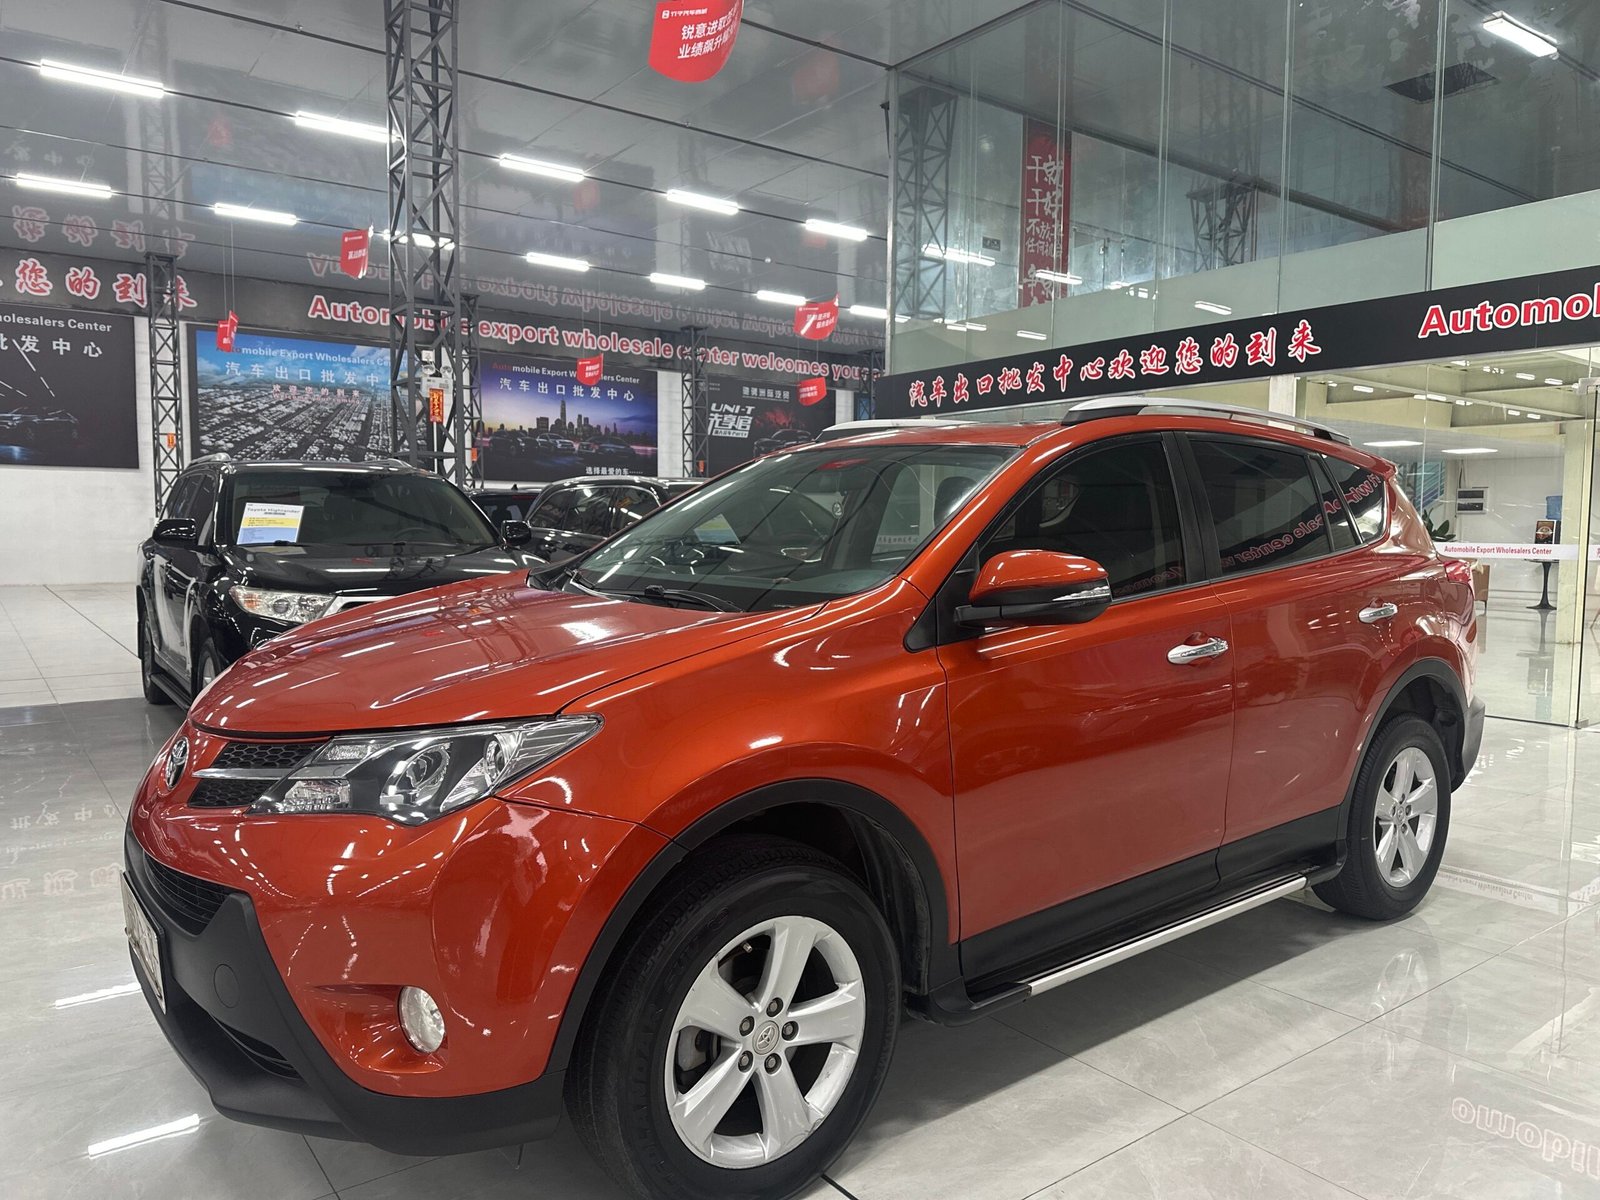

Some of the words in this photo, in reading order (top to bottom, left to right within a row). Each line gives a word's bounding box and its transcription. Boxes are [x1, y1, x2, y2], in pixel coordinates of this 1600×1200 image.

[67, 318, 112, 332] Center
[279, 348, 313, 361] Export
[315, 352, 376, 367] Wholesalers
[478, 320, 559, 345] export
[562, 328, 674, 358] wholesale
[741, 351, 829, 377] welcomes
[909, 319, 1321, 408] 汽车出口批发中心欢迎您的到来
[225, 361, 391, 386] 汽车出口批发中
[541, 367, 568, 378] Export
[615, 375, 640, 384] Center
[499, 377, 634, 402] 汽车出口批发中心
[711, 402, 755, 415] UNI-T
[1444, 545, 1476, 554] Automobile
[1476, 546, 1495, 555] Export
[1495, 546, 1531, 555] Wholesalers
[1532, 546, 1552, 555] Center
